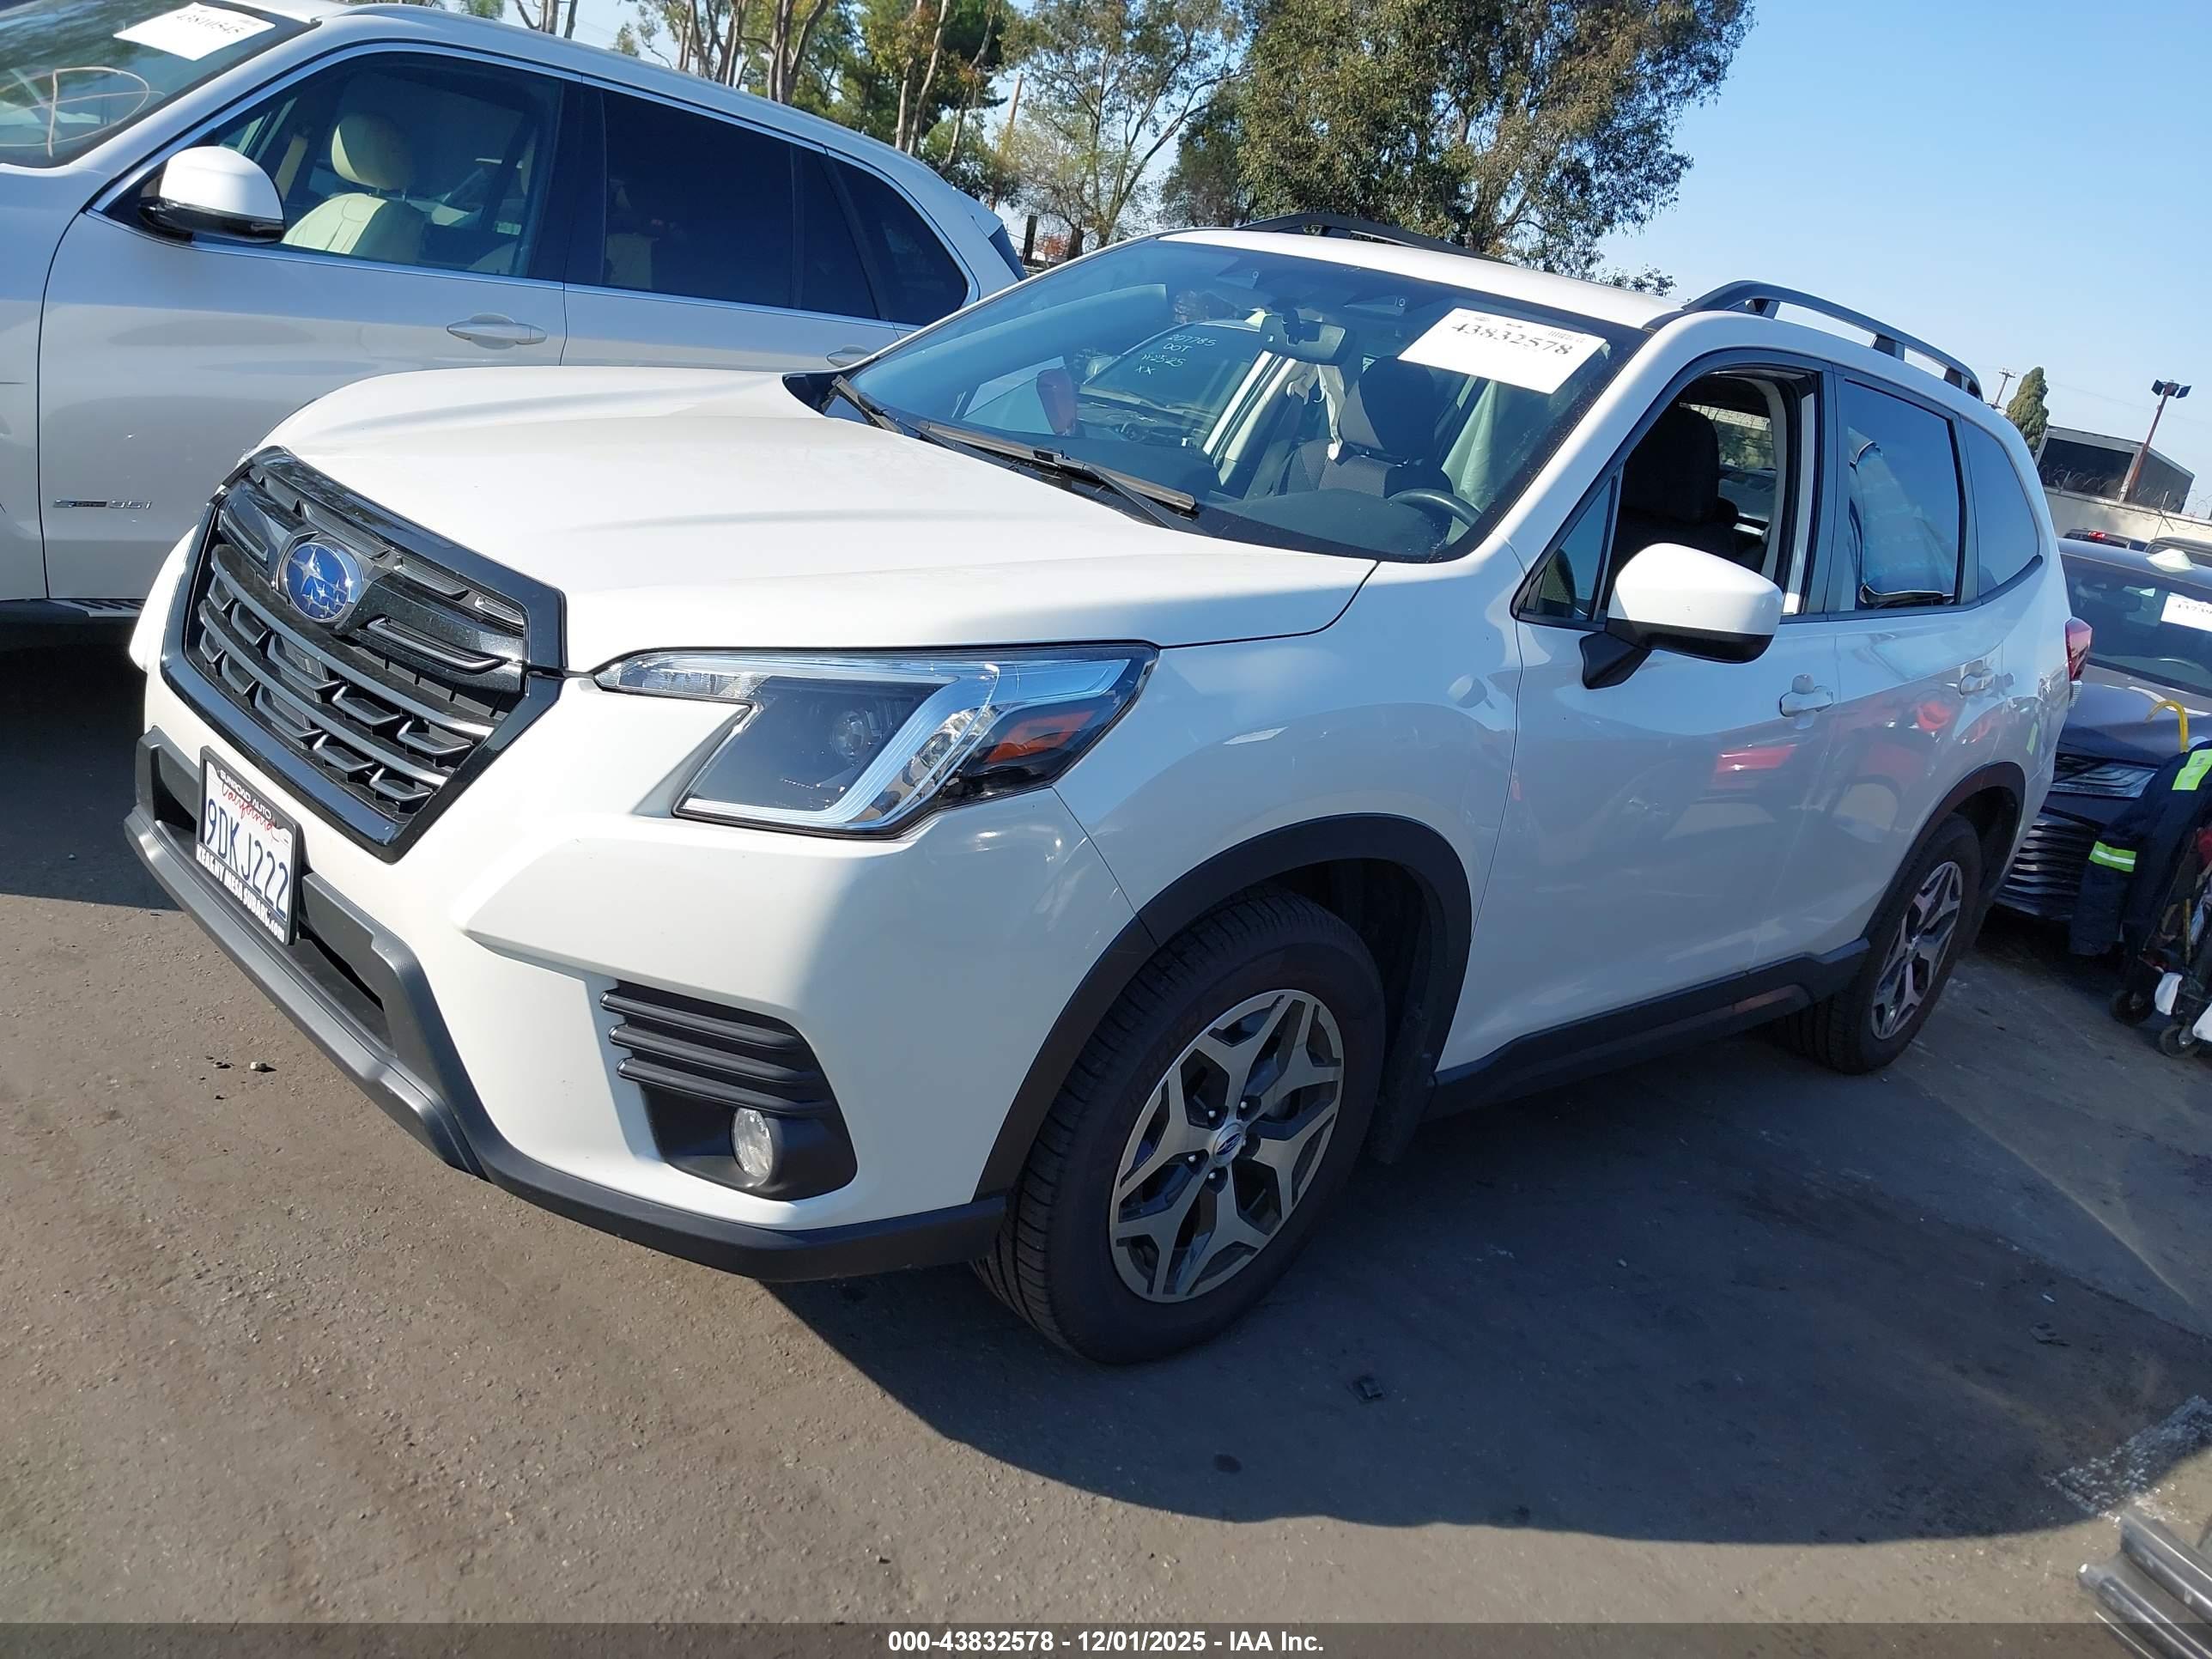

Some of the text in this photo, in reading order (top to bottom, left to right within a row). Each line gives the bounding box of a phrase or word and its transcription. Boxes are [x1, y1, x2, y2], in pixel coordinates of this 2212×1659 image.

[1451, 323, 1573, 355] 43832578
[252, 798, 272, 820] AUTO
[206, 798, 289, 917] 9DKJ222
[224, 869, 243, 902] MESA
